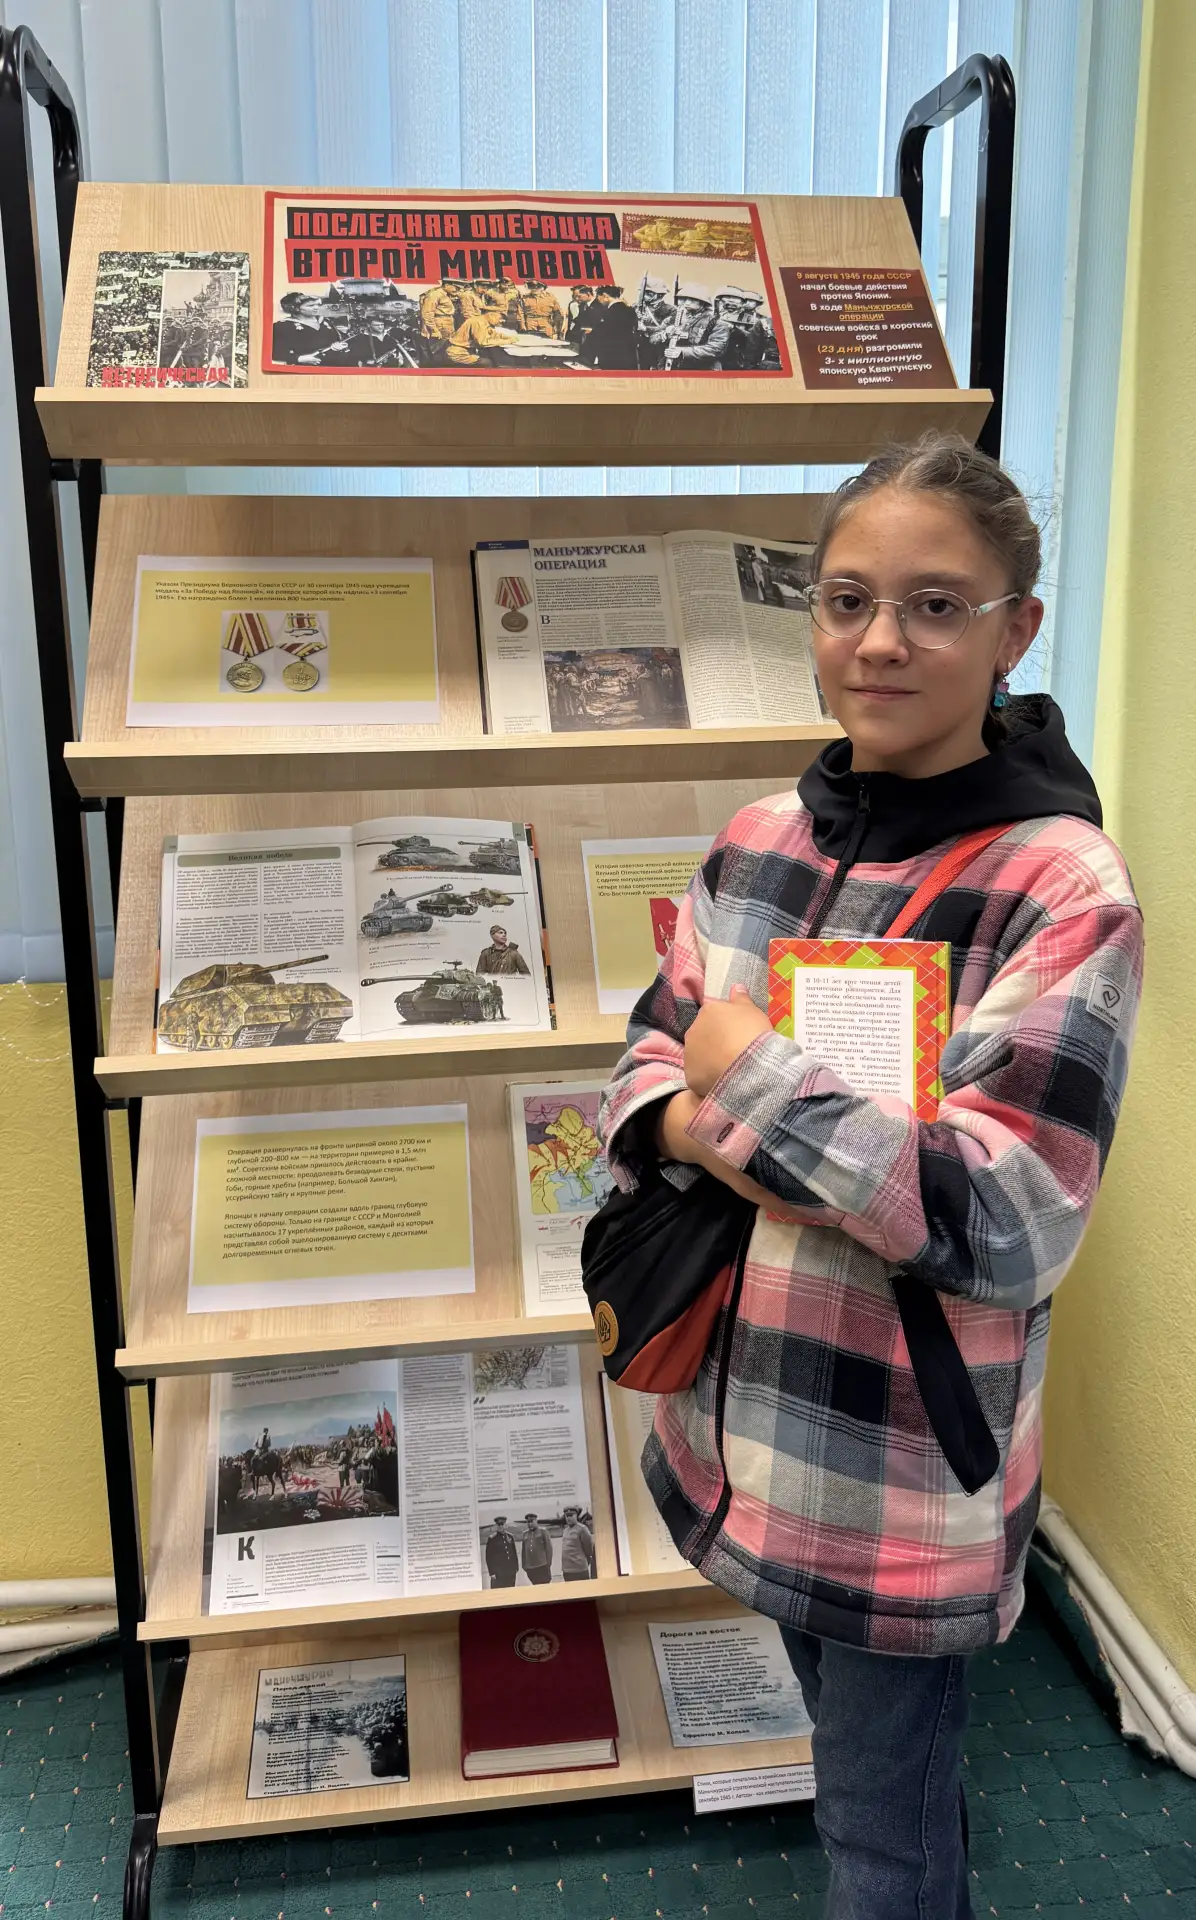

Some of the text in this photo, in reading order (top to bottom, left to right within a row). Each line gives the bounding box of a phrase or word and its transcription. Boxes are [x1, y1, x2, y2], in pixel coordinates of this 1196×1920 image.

[293, 212, 614, 241] ПОСЛЕДНЯЯ ОПЕРАЦИЯ
[292, 244, 604, 280] ВТОРОЙ МИРОВОЙ
[797, 272, 802, 280] 9
[805, 273, 838, 281] августа
[840, 272, 860, 280] 1945
[828, 283, 863, 291] боевые
[821, 293, 853, 301] против
[844, 303, 913, 311] Маньчжурской
[839, 313, 884, 321] операции
[890, 322, 933, 330] короткий
[818, 342, 922, 354] (23 дня) разгромили
[847, 354, 922, 364] миллионную
[819, 363, 932, 375] японскую Квантунскую
[102, 367, 229, 382] ИСТОРИЧЕСКАЯ
[858, 375, 893, 384] армию.
[533, 544, 646, 557] МАНЬЧЖУРСКАЯ
[534, 559, 607, 571] ОПЕРАЦИЯ
[541, 615, 550, 625] В
[227, 1148, 261, 1156] Операция
[263, 1146, 309, 1154] развернулась
[320, 1143, 344, 1151] фронте
[227, 1156, 259, 1164] глубиной
[297, 1170, 344, 1179] преодолевать
[226, 1193, 269, 1201] уссурийскую
[371, 1203, 395, 1211] границ
[323, 1215, 351, 1223] границе
[224, 1230, 276, 1238] насчитывалось
[335, 1224, 366, 1232] районов,
[358, 1231, 385, 1239] систему
[223, 1250, 282, 1259] долговременных
[237, 1535, 255, 1562] К
